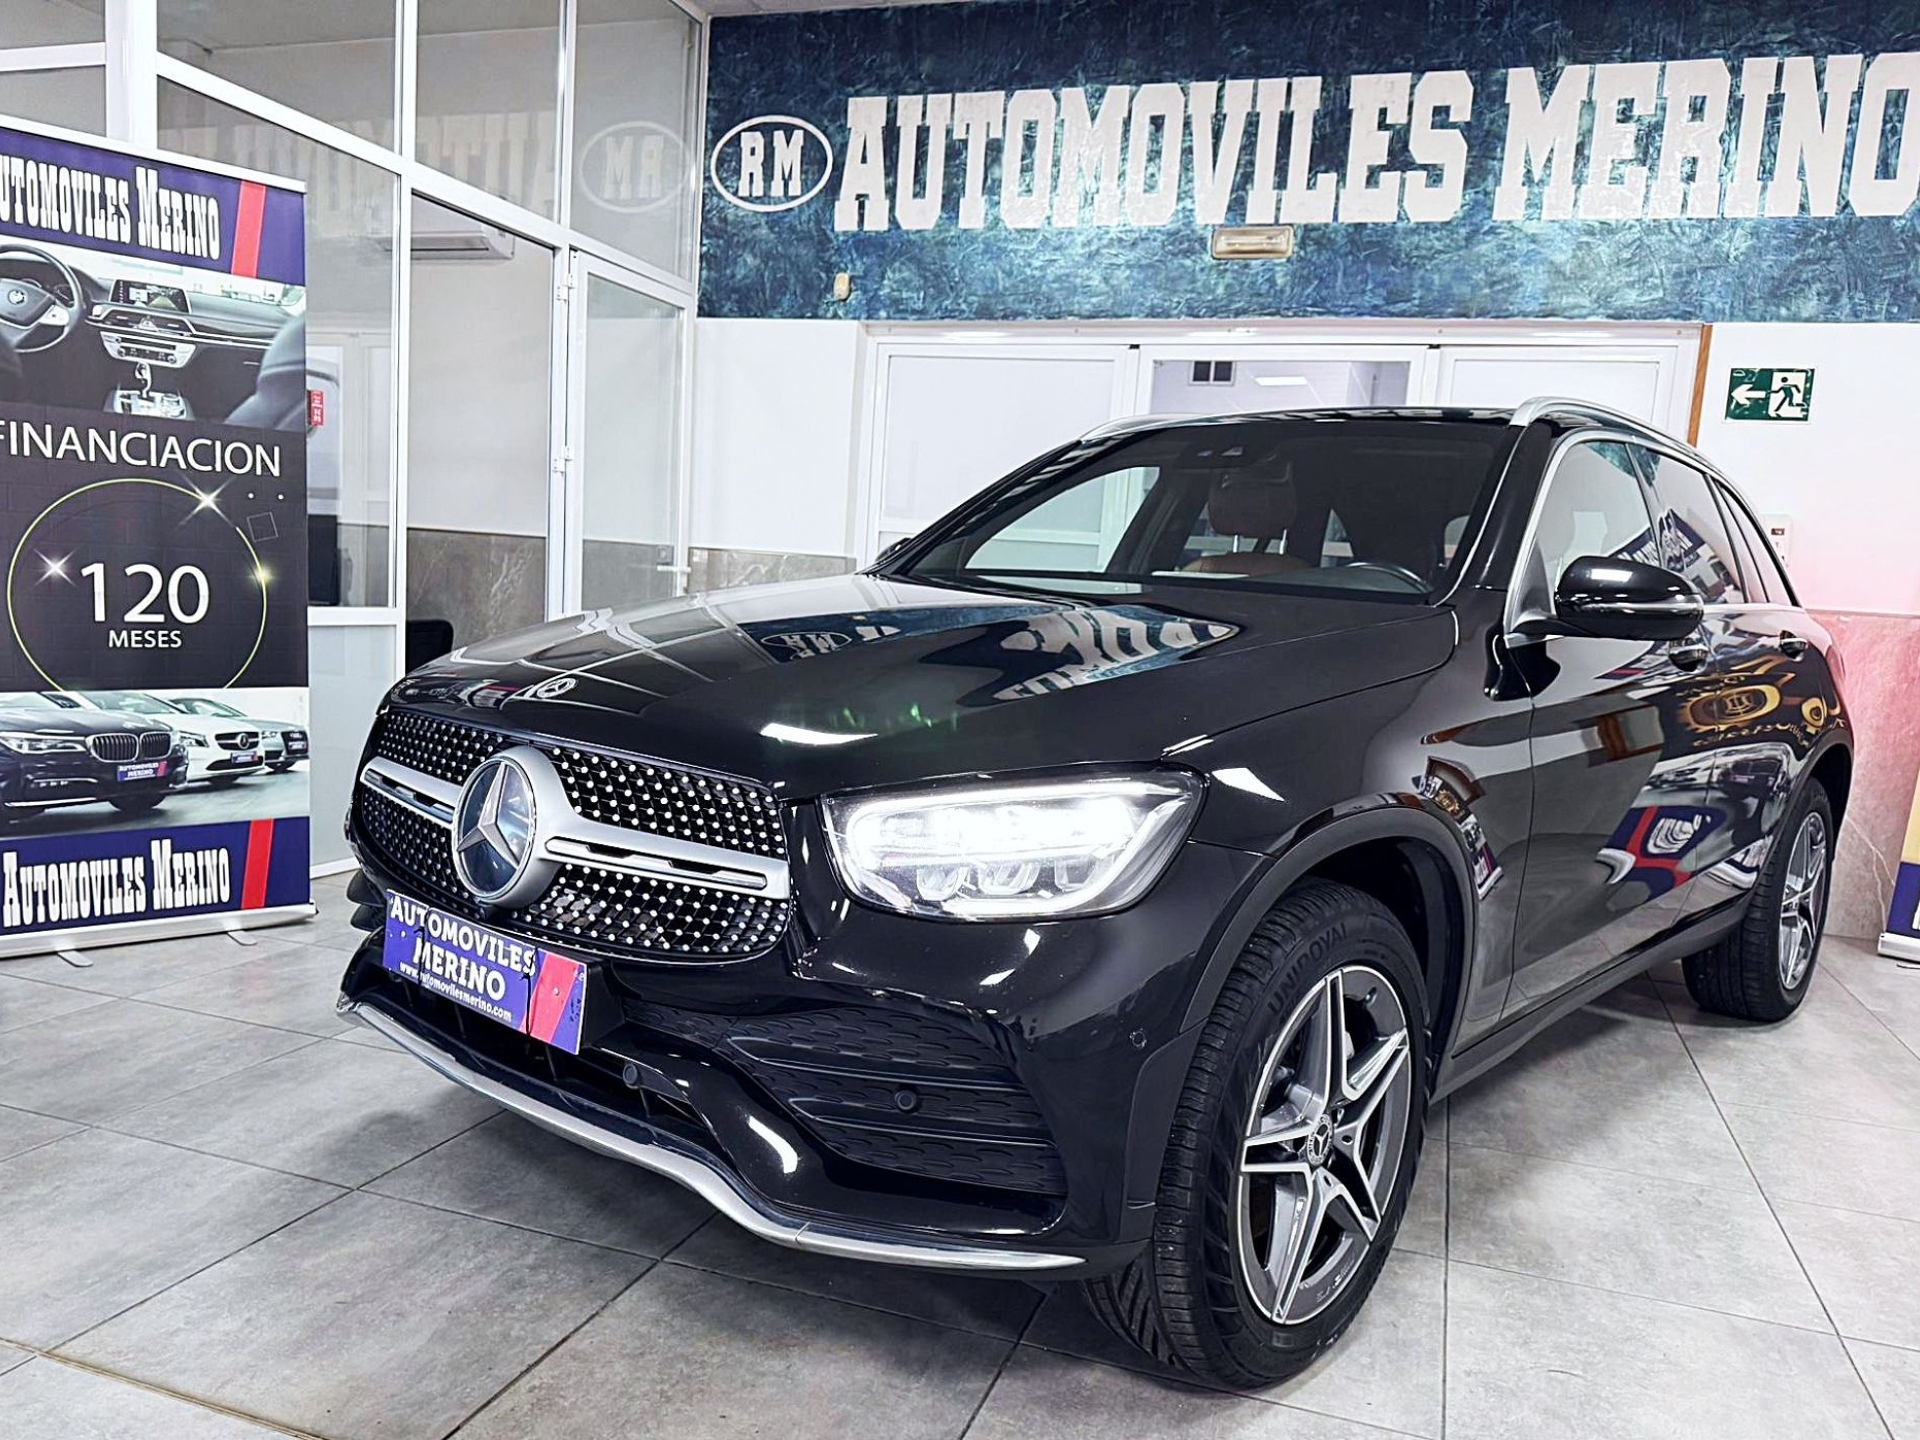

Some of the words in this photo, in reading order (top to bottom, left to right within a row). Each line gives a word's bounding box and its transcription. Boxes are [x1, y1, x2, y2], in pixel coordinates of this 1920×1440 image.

[738, 129, 804, 197] RM
[834, 70, 1474, 231] AUTOMOVILES
[1492, 52, 1920, 222] MERINO
[136, 166, 220, 260] MERINO
[81, 562, 209, 625] 120
[108, 630, 182, 649] MESES
[3, 851, 146, 927] AUTOMOVILES
[151, 839, 230, 910] MERINO
[390, 895, 536, 977] AUTOMOVILES
[413, 937, 506, 1001] MERINO
